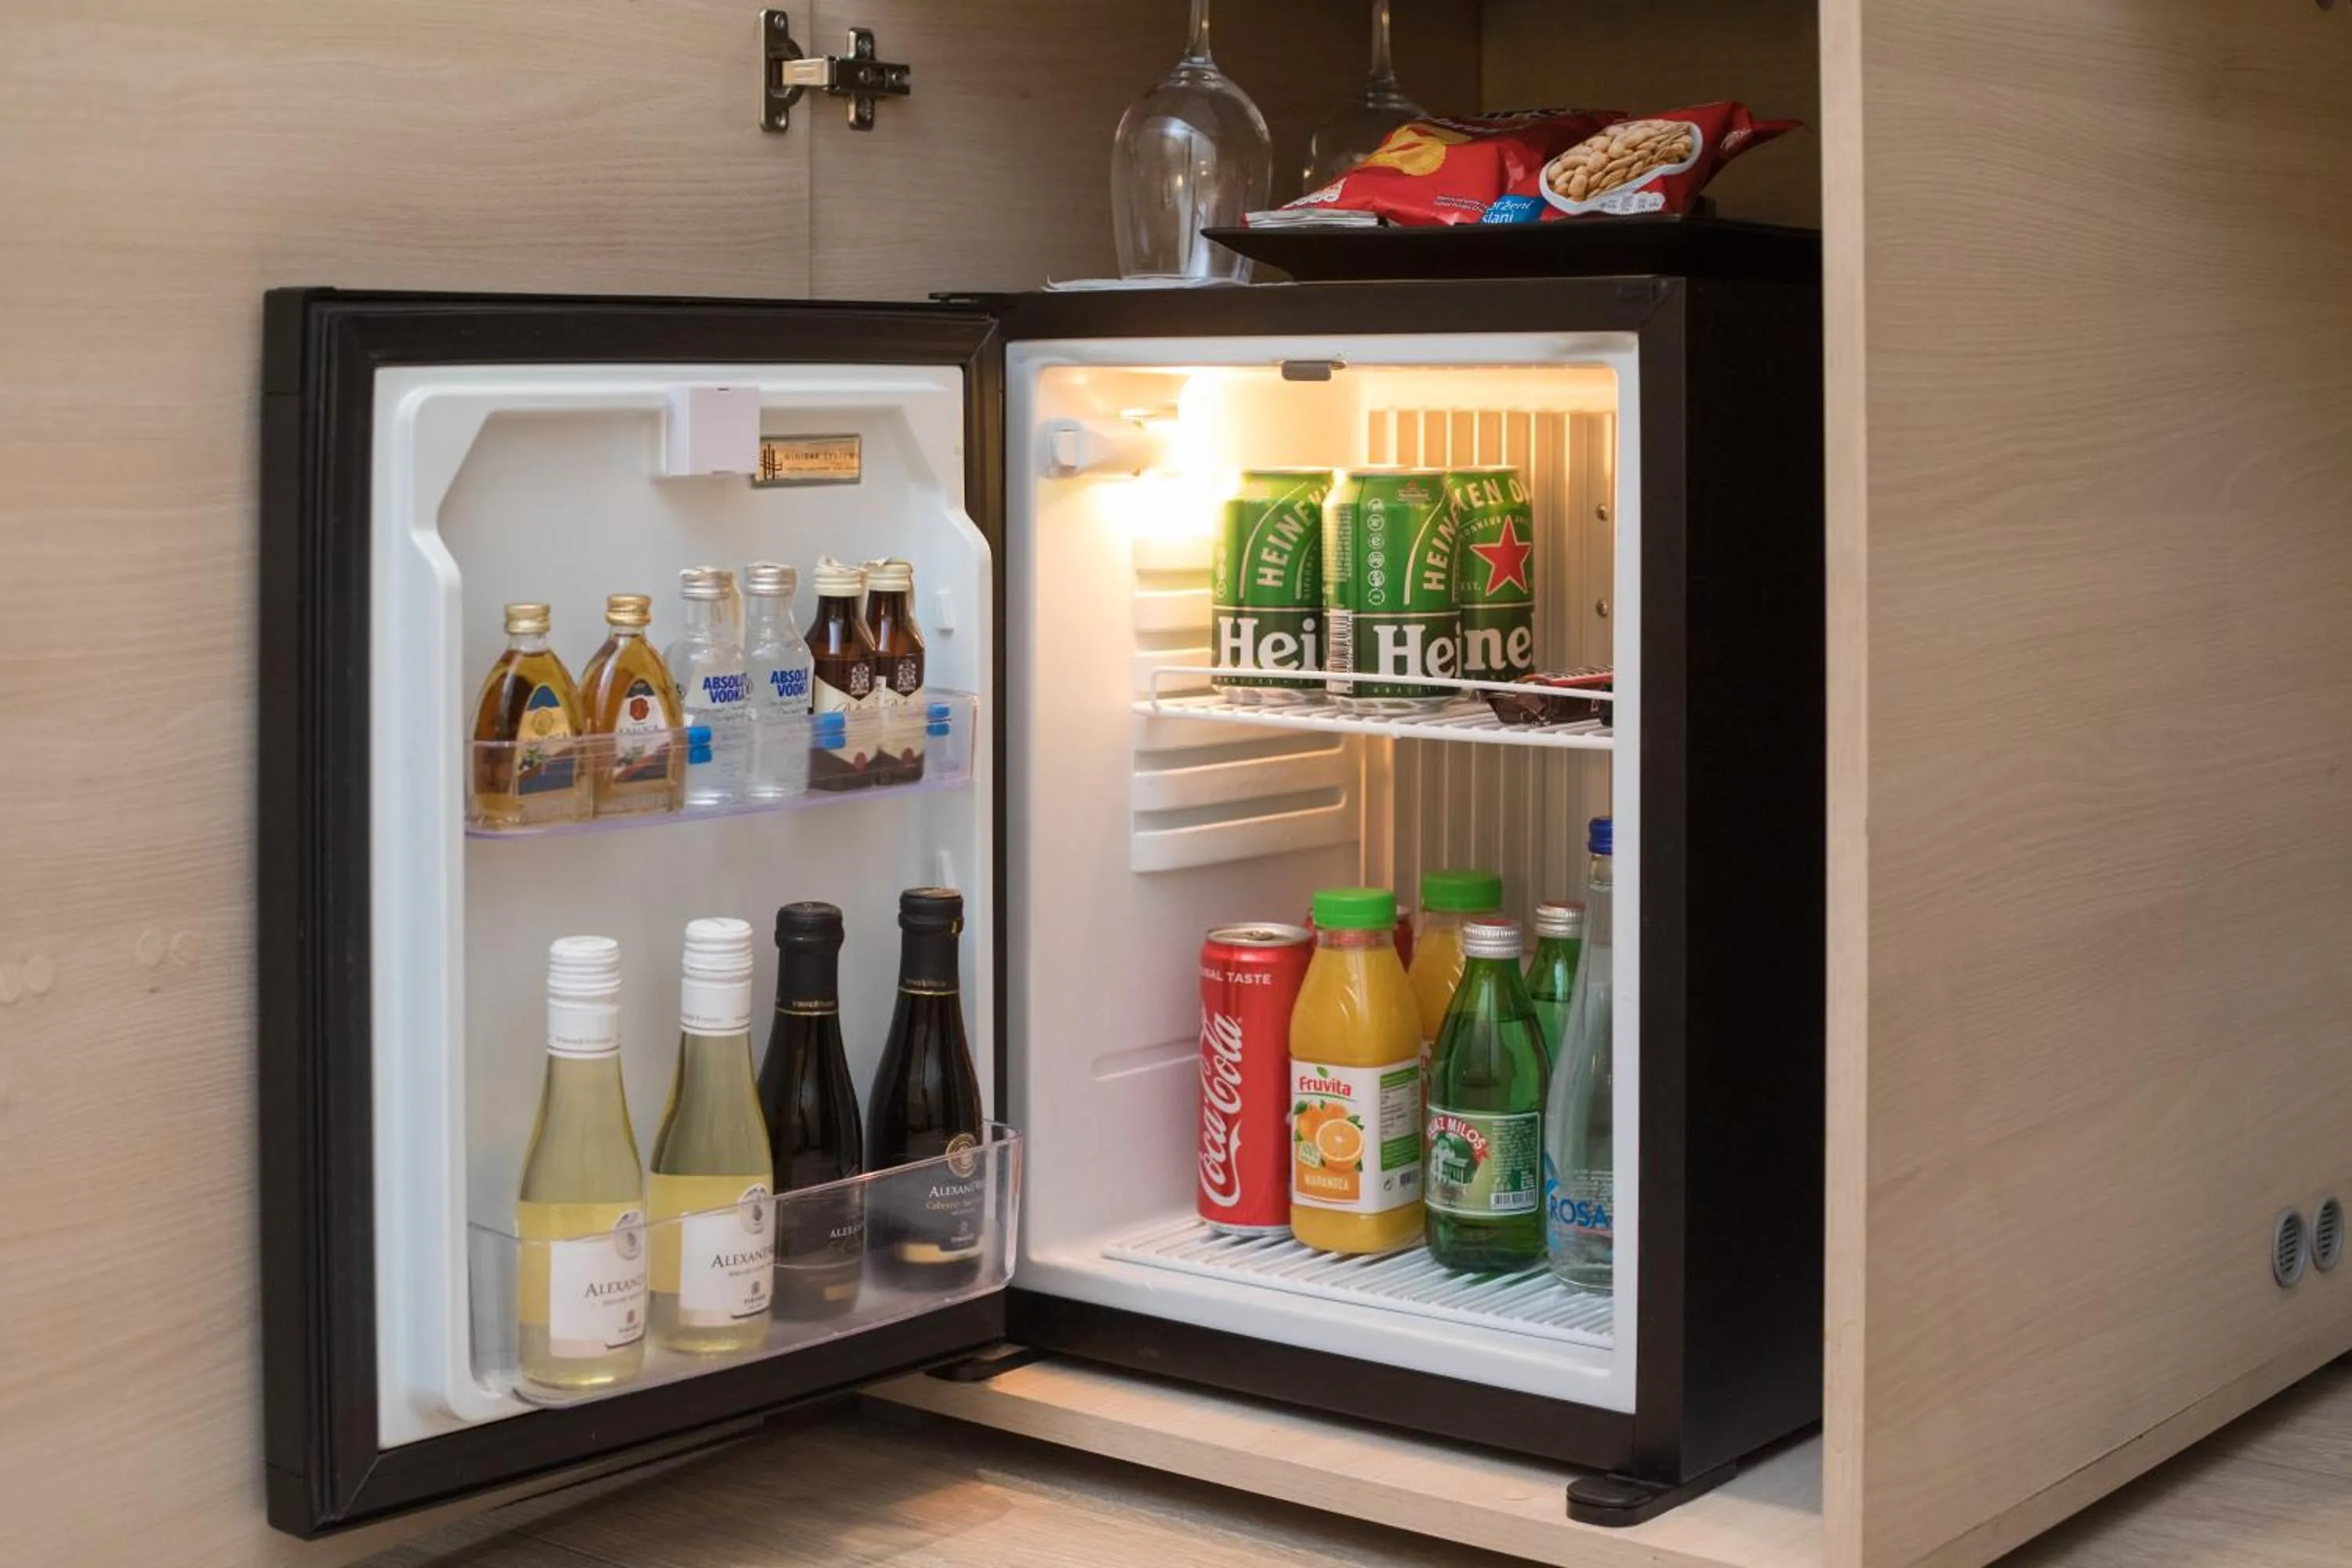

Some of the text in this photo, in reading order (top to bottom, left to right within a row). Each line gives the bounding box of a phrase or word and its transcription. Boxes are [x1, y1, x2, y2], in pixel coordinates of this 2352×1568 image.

[1225, 971, 1272, 985] TASTE
[1299, 1076, 1352, 1097] Fruvita
[1550, 1194, 1613, 1231] ROSA
